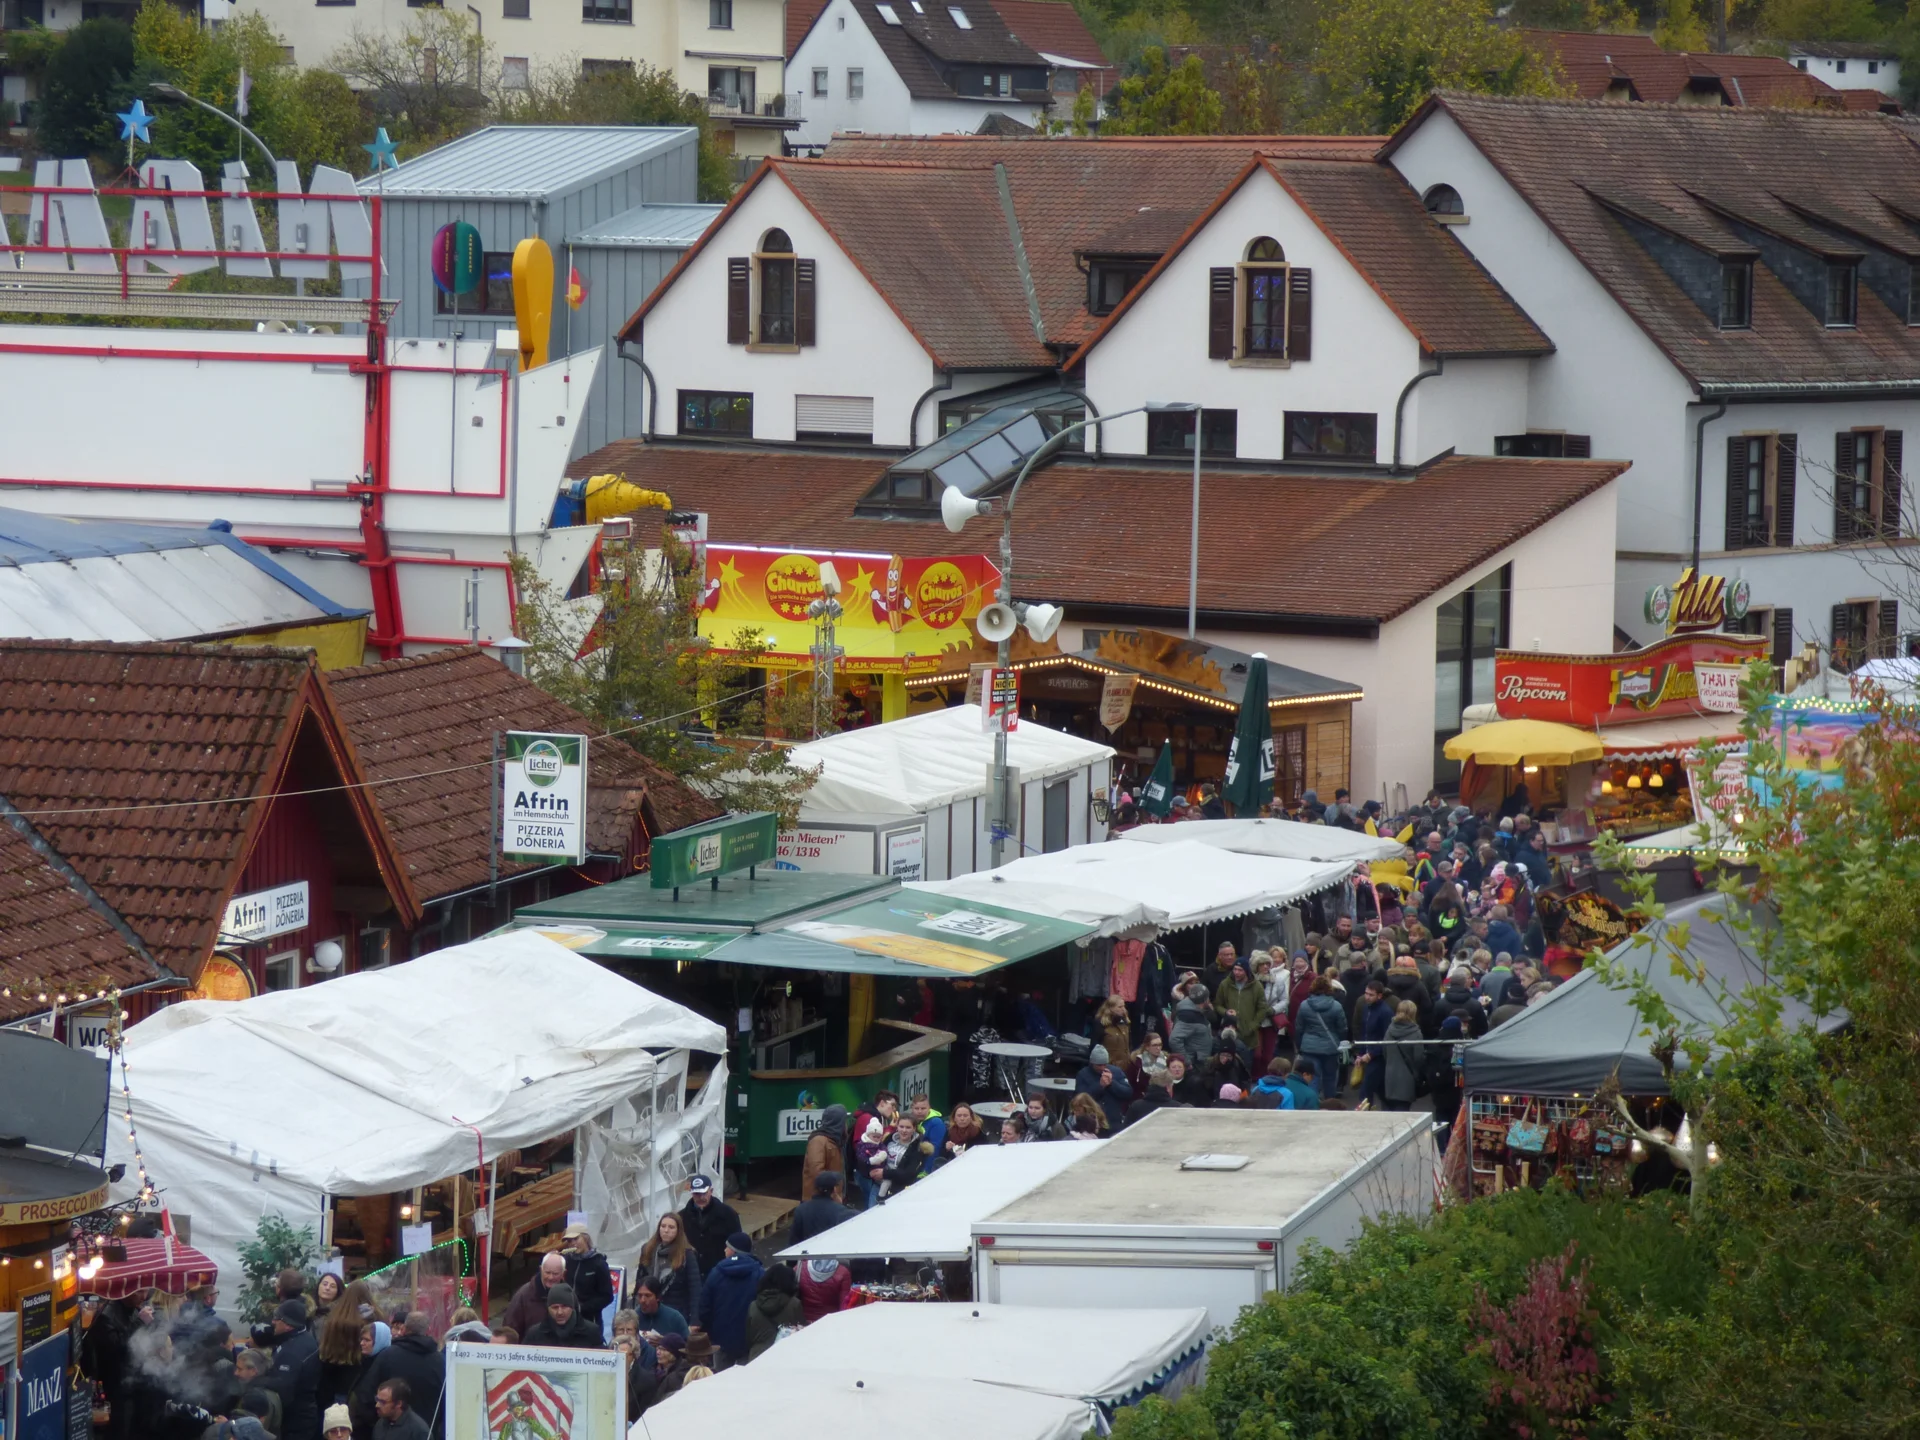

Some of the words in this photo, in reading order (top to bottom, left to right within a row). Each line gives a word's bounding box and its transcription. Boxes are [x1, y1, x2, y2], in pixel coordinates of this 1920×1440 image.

[766, 571, 824, 595] Churros
[920, 582, 963, 602] Churros
[870, 662, 902, 670] Company
[1497, 675, 1567, 703] Popcorn
[1701, 671, 1726, 687] THAI
[1730, 674, 1740, 688] F
[529, 757, 557, 771] Licher
[514, 790, 569, 811] Afrin
[513, 809, 523, 817] im
[523, 809, 570, 820] Hemmschuh
[517, 825, 565, 837] PIZZERIA
[516, 834, 566, 849] DÖNERIA
[700, 841, 719, 867] Licher
[276, 890, 304, 910] PIZZERIA
[233, 901, 266, 929] Afrin
[276, 907, 305, 928] DÖNERIA
[903, 1072, 927, 1111] Licher
[786, 1114, 823, 1136] Liche
[20, 1196, 87, 1221] PROSECCO
[90, 1192, 99, 1209] IM
[495, 1353, 507, 1361] 525
[508, 1352, 525, 1362] Jahre
[526, 1352, 574, 1364] Schützenwesen
